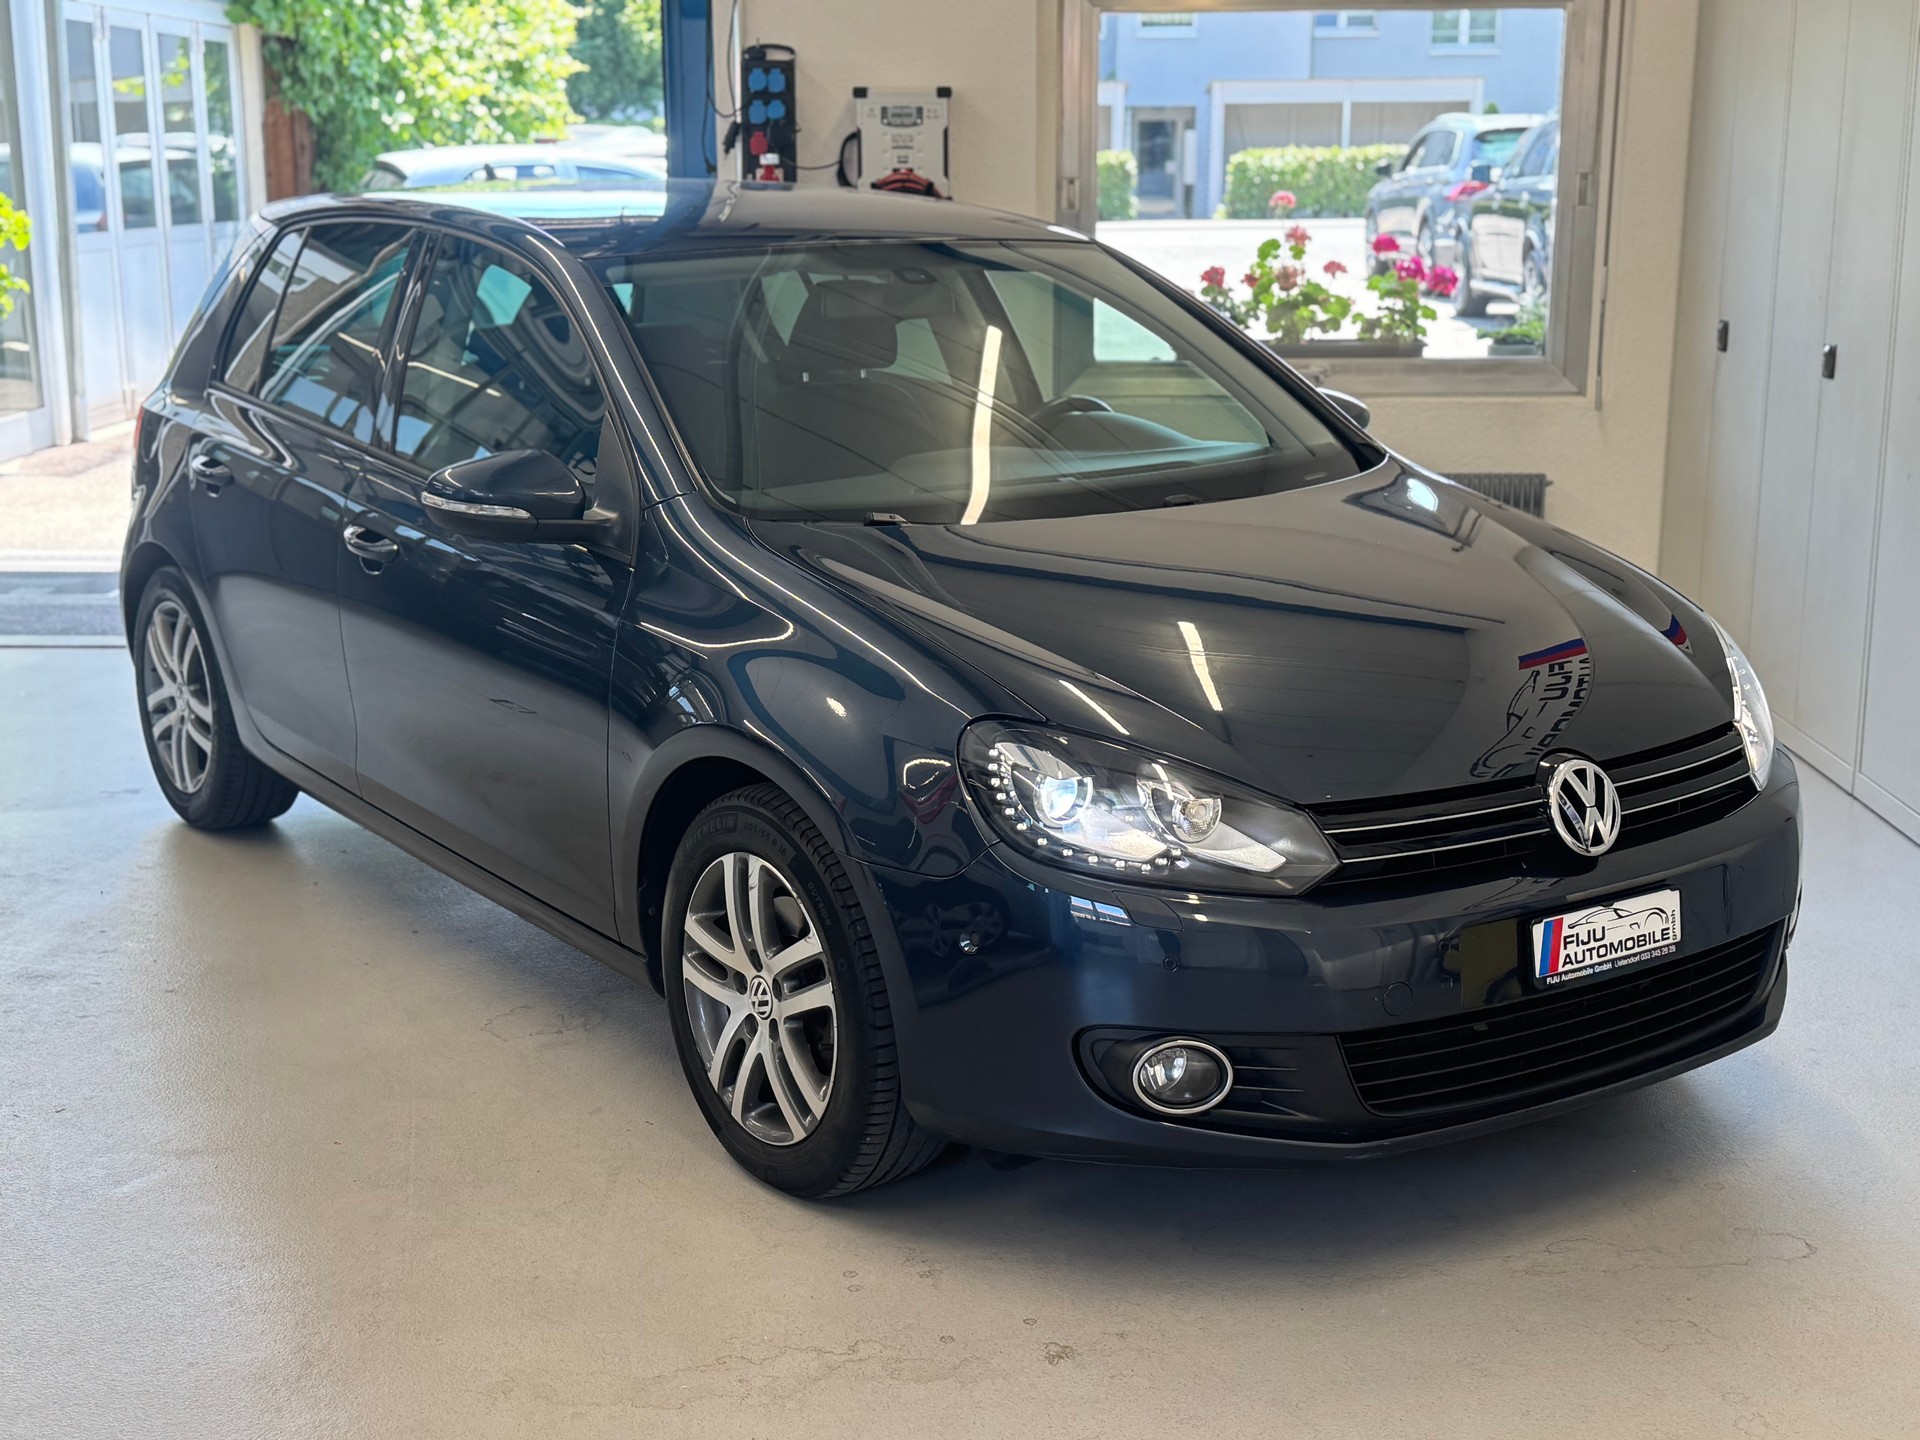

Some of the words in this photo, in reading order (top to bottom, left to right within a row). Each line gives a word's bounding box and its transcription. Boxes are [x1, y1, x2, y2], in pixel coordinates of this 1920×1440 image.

[1562, 926, 1670, 968] AUTOMOBILE
[1563, 925, 1606, 950] FIJU
[1546, 974, 1560, 985] FIJU
[1561, 967, 1594, 981] Automobile
[1594, 961, 1613, 974] GmbH
[1641, 952, 1651, 961] 033
[1652, 949, 1661, 958] 345
